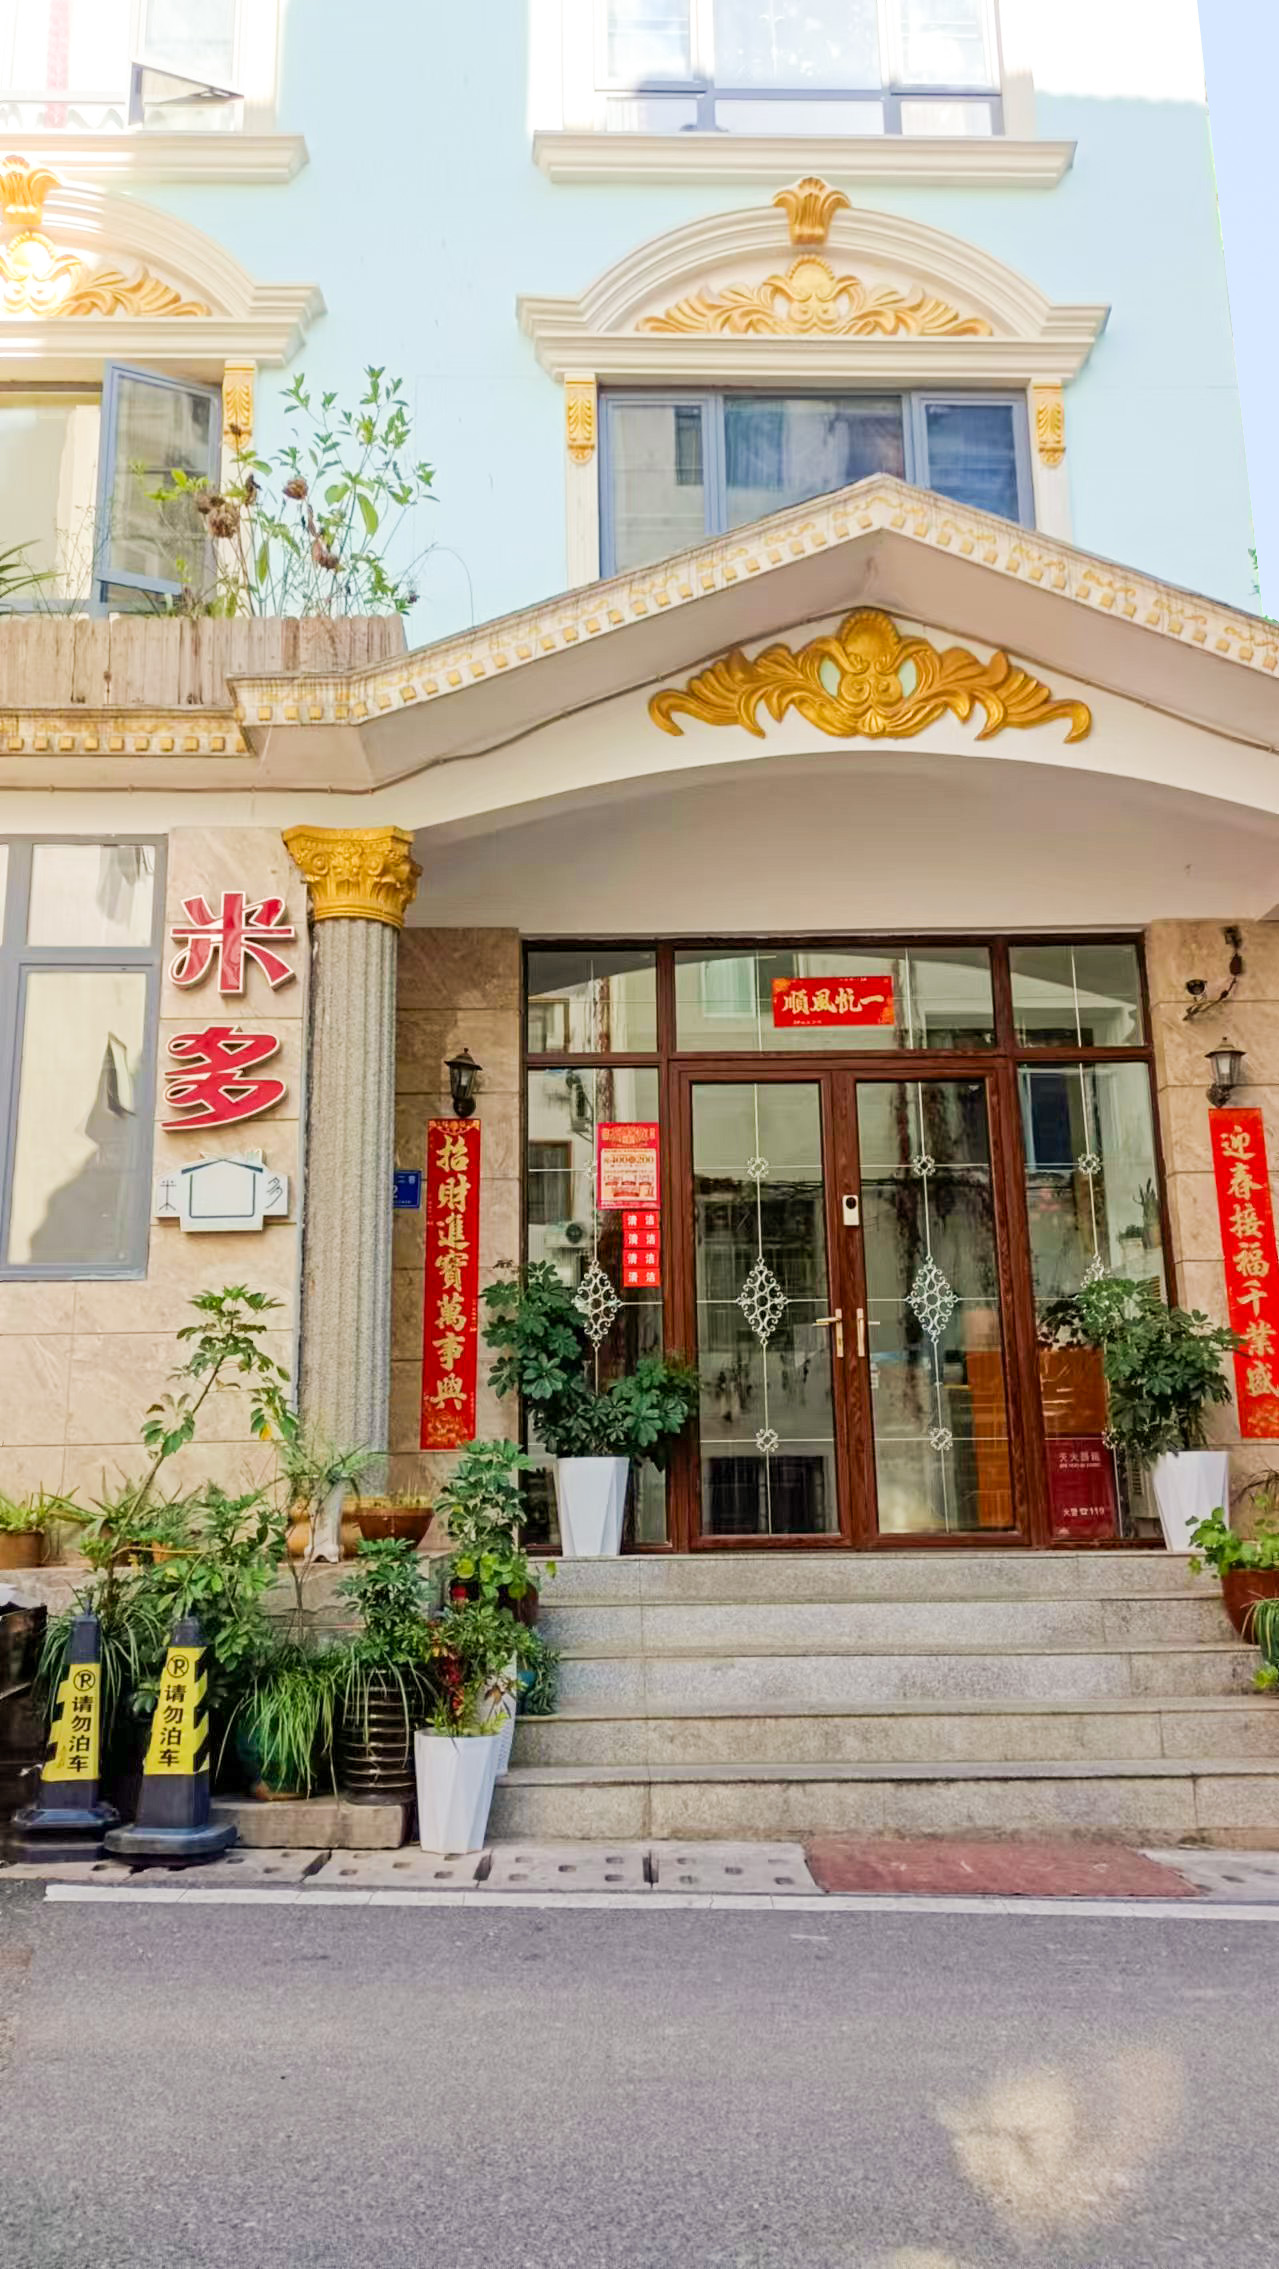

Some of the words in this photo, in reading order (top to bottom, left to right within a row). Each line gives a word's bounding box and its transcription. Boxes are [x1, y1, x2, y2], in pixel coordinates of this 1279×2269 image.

[161, 890, 296, 1134] 米多
[67, 1695, 93, 1773] 请勿泊车
[158, 1684, 187, 1767] 请勿泊车
